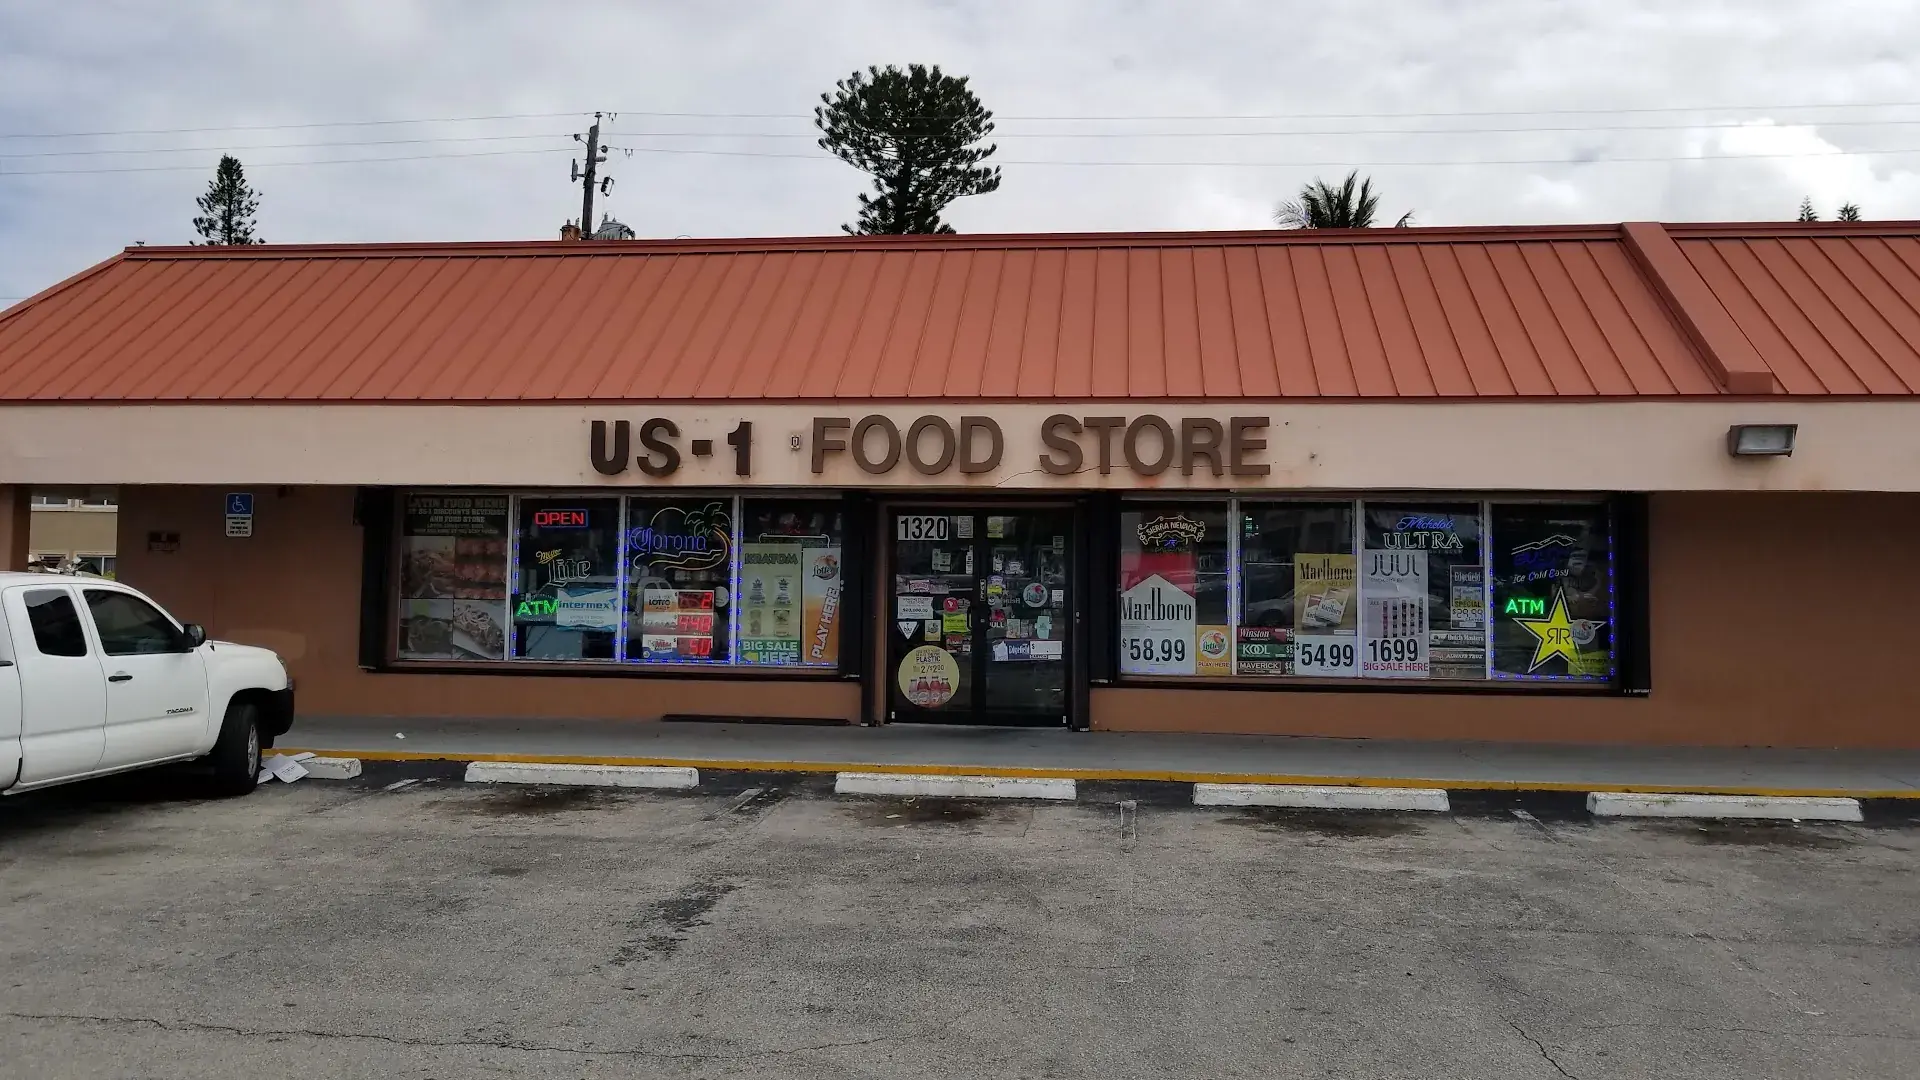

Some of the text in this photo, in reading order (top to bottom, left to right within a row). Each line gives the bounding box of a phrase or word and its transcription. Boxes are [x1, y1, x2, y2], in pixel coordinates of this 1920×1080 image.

[591, 414, 1271, 477] US-1 FOOD STORE
[535, 512, 584, 525] OPEN
[1396, 516, 1454, 530] Michelob
[901, 517, 948, 539] 1320
[1146, 521, 1198, 536] SIERRA NEVADA
[630, 527, 707, 554] Corona
[1382, 531, 1465, 549] ULTRA
[744, 553, 799, 565] KRATOM
[1370, 554, 1420, 577] JUUL
[547, 559, 591, 587] Lite
[1300, 558, 1353, 580] Marlboro
[1549, 568, 1569, 579] Easy
[518, 600, 558, 617] ATM
[559, 601, 609, 609] intermex
[1121, 587, 1192, 621] Marlboro
[1505, 599, 1545, 614] ATM
[811, 587, 841, 660] PLAY HERE
[1240, 628, 1270, 638] Winston
[743, 642, 798, 651] BIG SALE
[1242, 644, 1271, 655] KOOL
[1368, 638, 1419, 662] 16.99
[1295, 643, 1355, 669] $54.99
[1364, 663, 1379, 671] BIG
[1380, 663, 1404, 672] SALE
[1405, 663, 1429, 672] HERE
[166, 706, 193, 714] TACOMA
